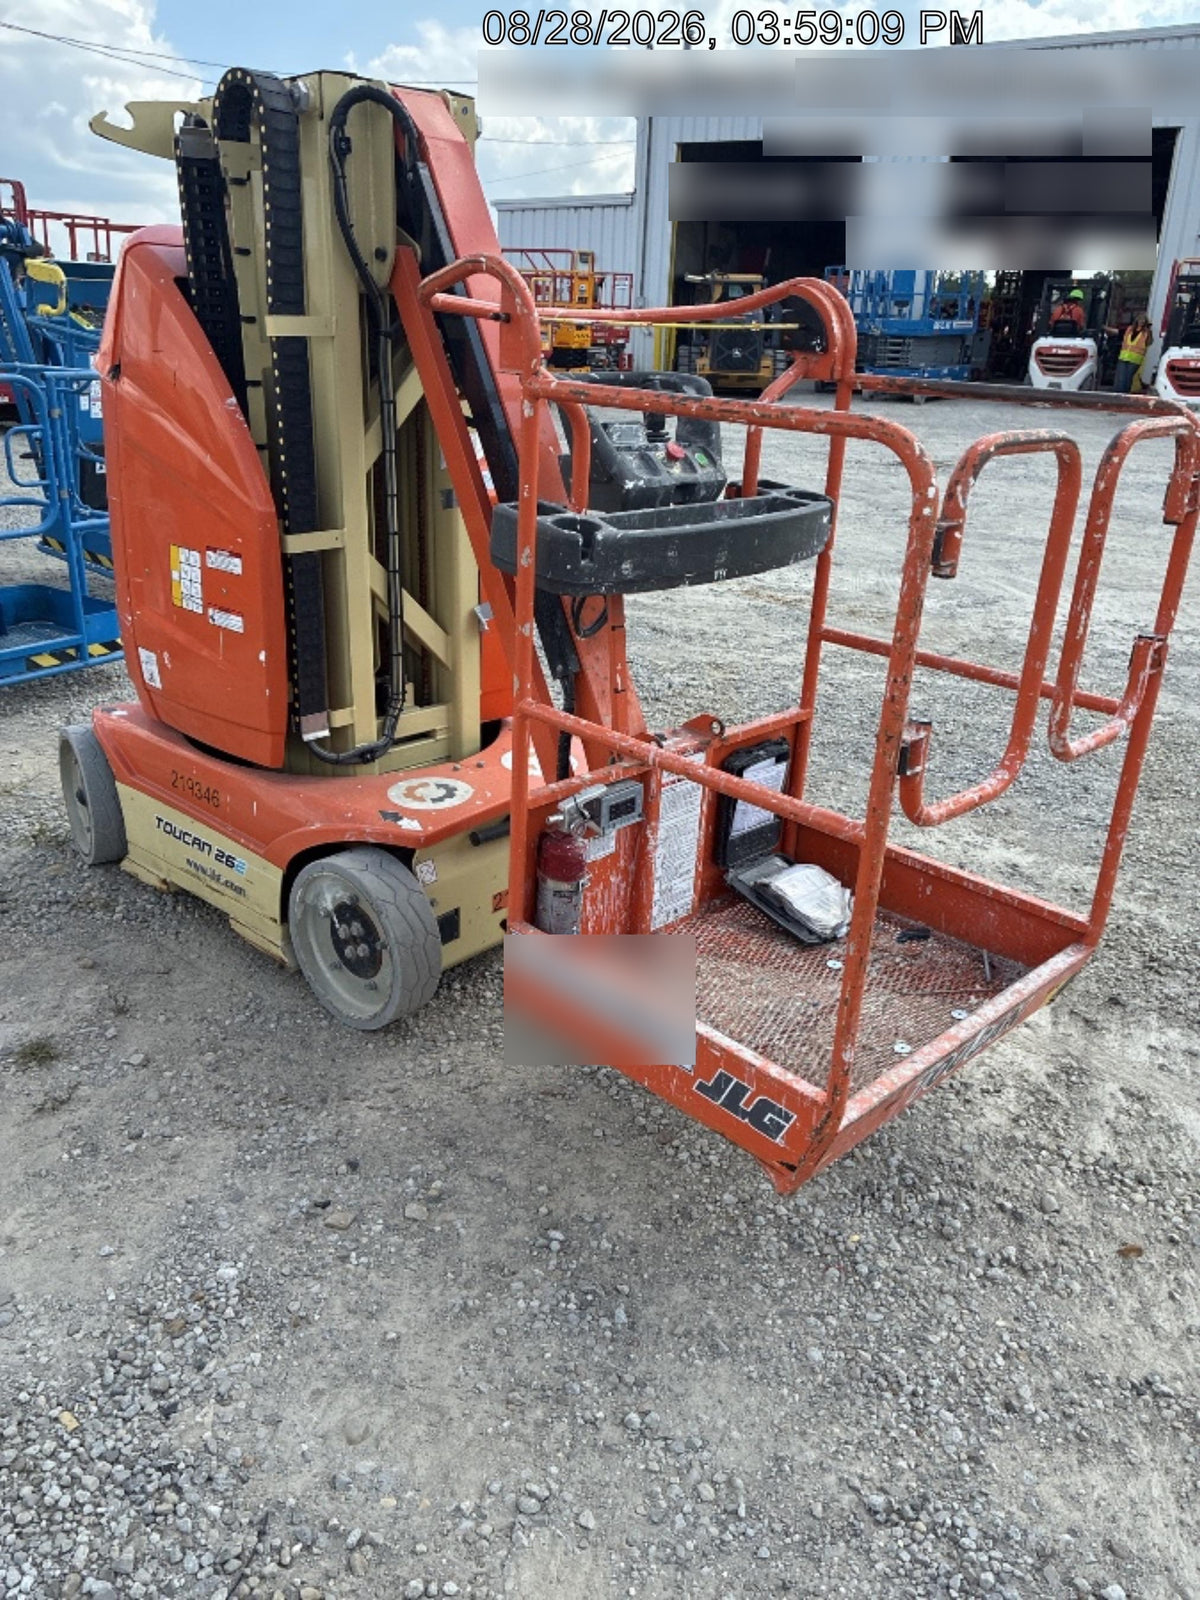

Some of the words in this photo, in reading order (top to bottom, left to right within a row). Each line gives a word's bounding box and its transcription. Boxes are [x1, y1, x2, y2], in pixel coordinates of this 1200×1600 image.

[171, 769, 220, 808] 219346
[155, 815, 212, 857] TOUCAN
[692, 1067, 798, 1144] JLG
